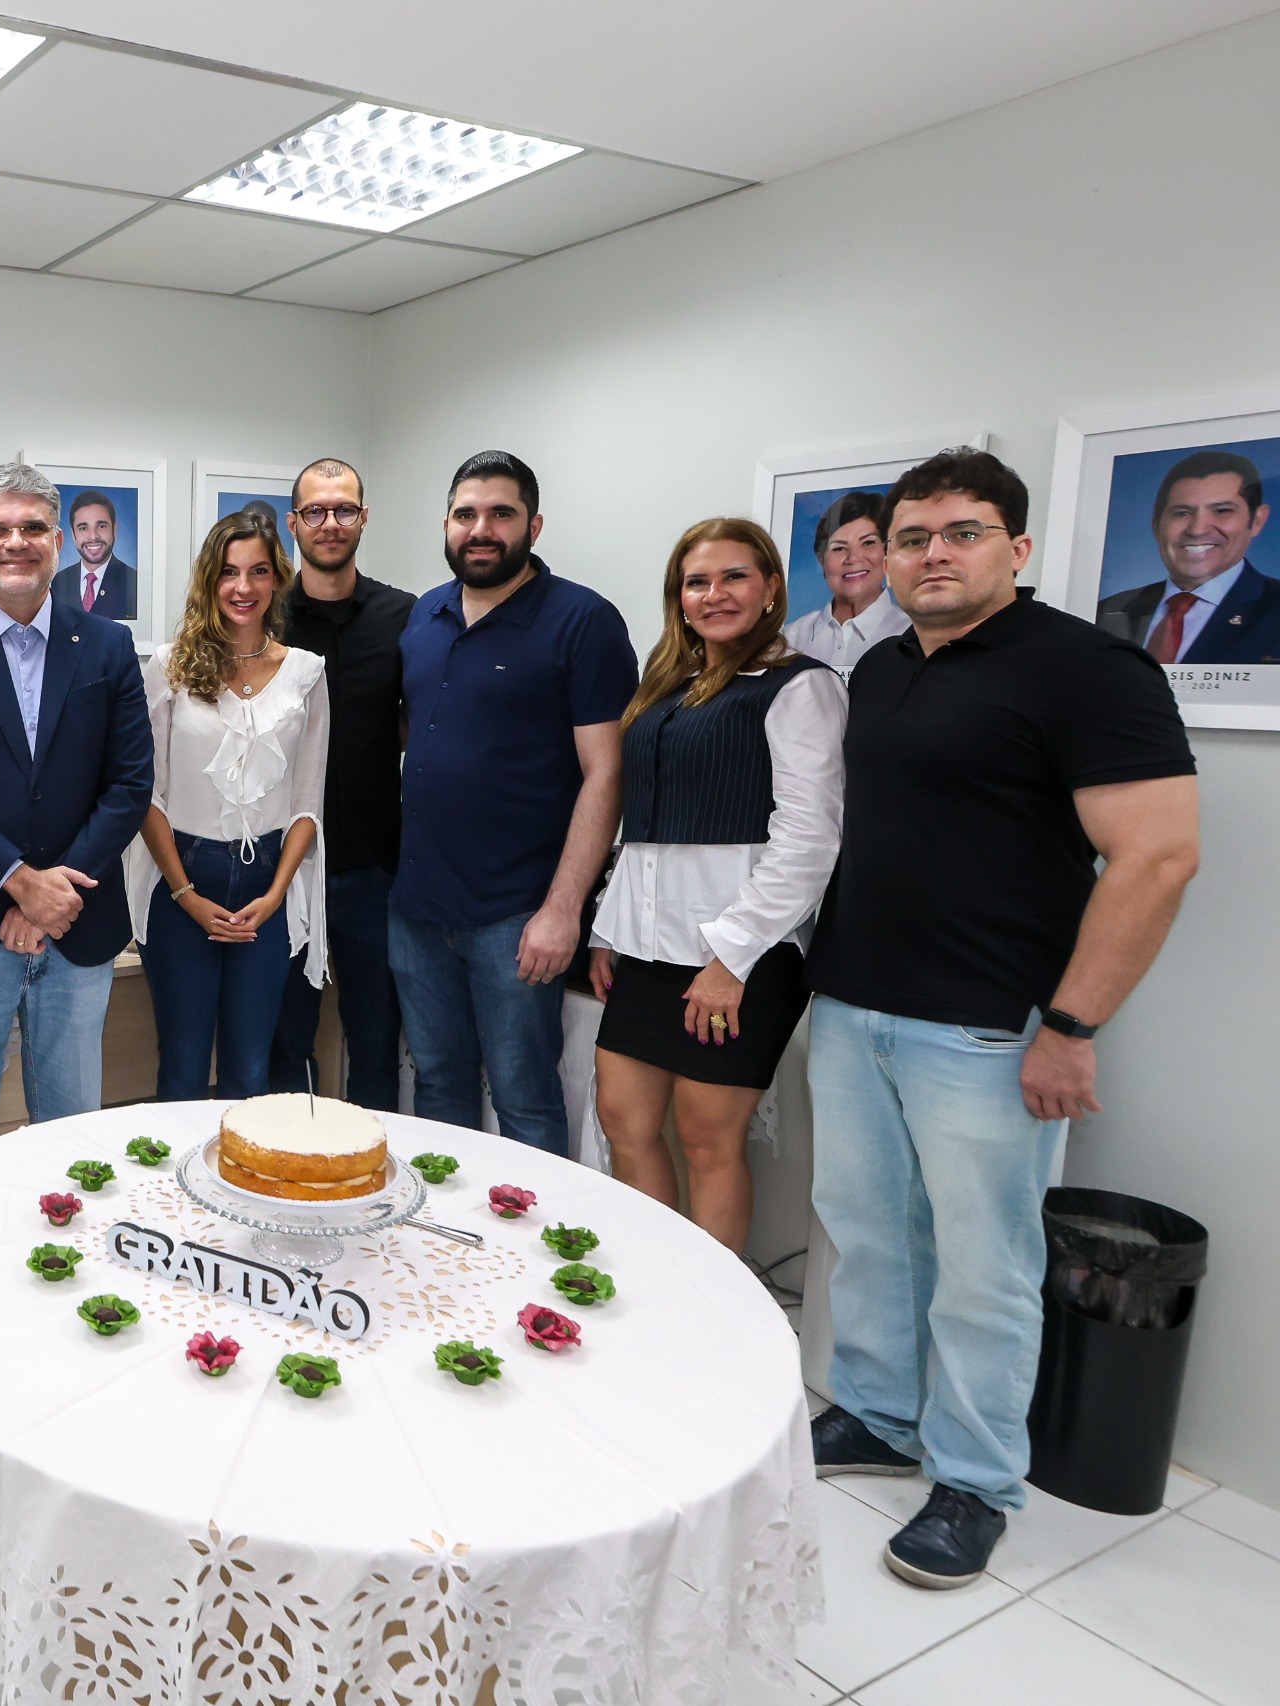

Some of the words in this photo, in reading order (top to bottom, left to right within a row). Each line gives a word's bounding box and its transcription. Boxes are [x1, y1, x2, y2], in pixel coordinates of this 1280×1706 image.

[1165, 671, 1194, 681] SIS
[1203, 672, 1252, 682] DINIZ
[1191, 682, 1221, 690] 2024
[106, 1222, 370, 1341] GRATIDÃO
